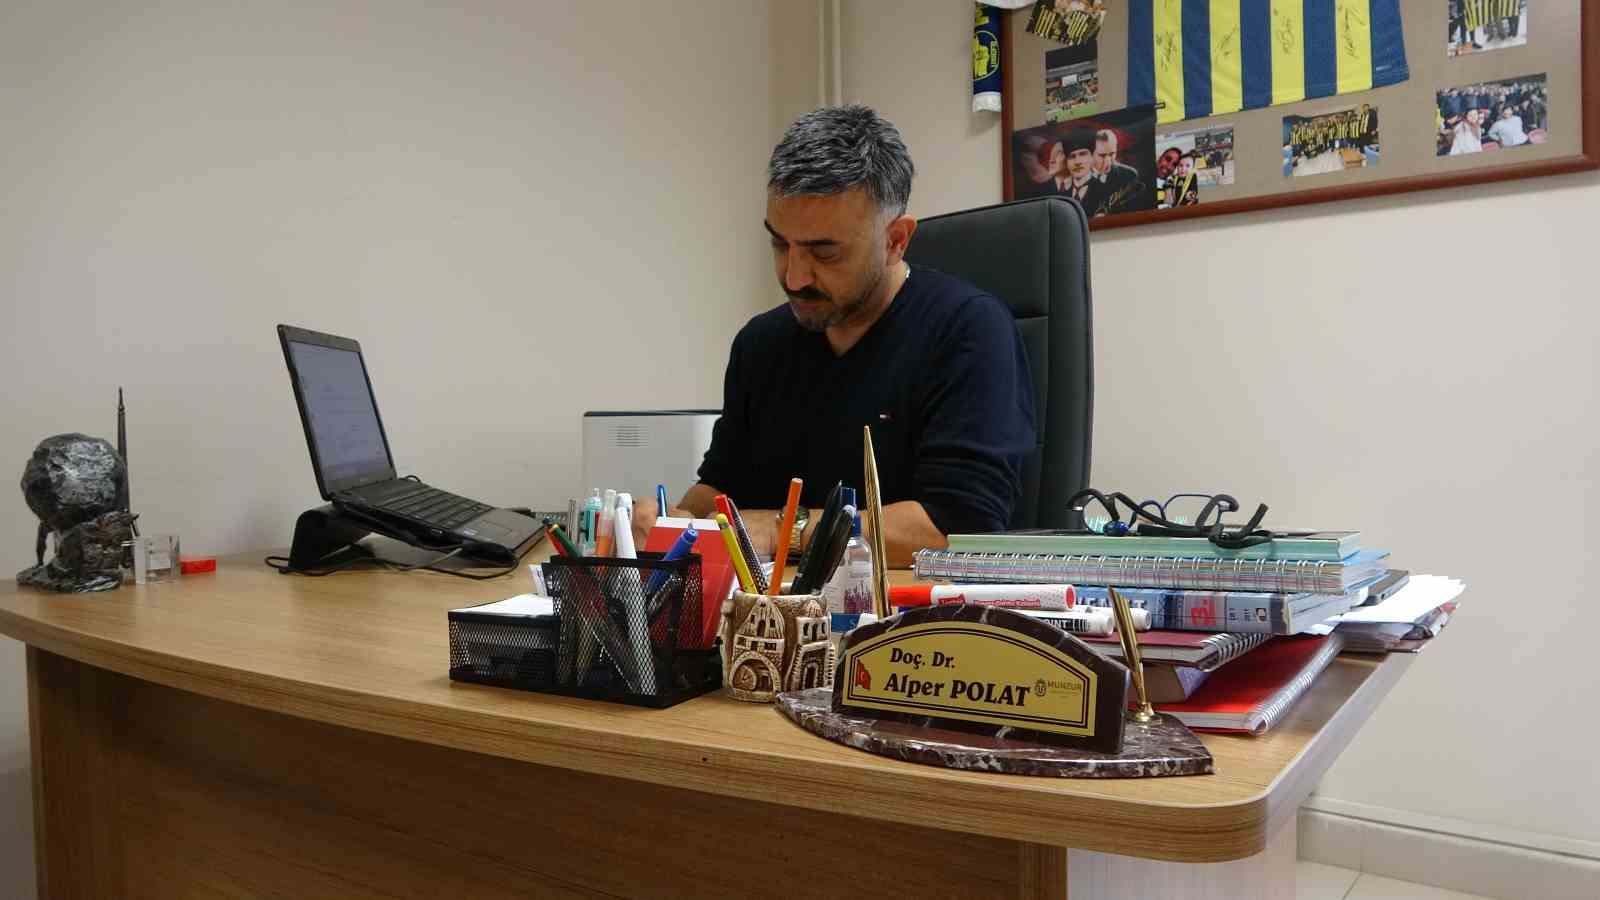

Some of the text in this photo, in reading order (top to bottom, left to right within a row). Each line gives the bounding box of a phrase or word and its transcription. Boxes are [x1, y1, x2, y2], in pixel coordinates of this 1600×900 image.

[890, 648, 956, 669] Doç. Dr.
[883, 673, 1031, 706] Alper POLAT
